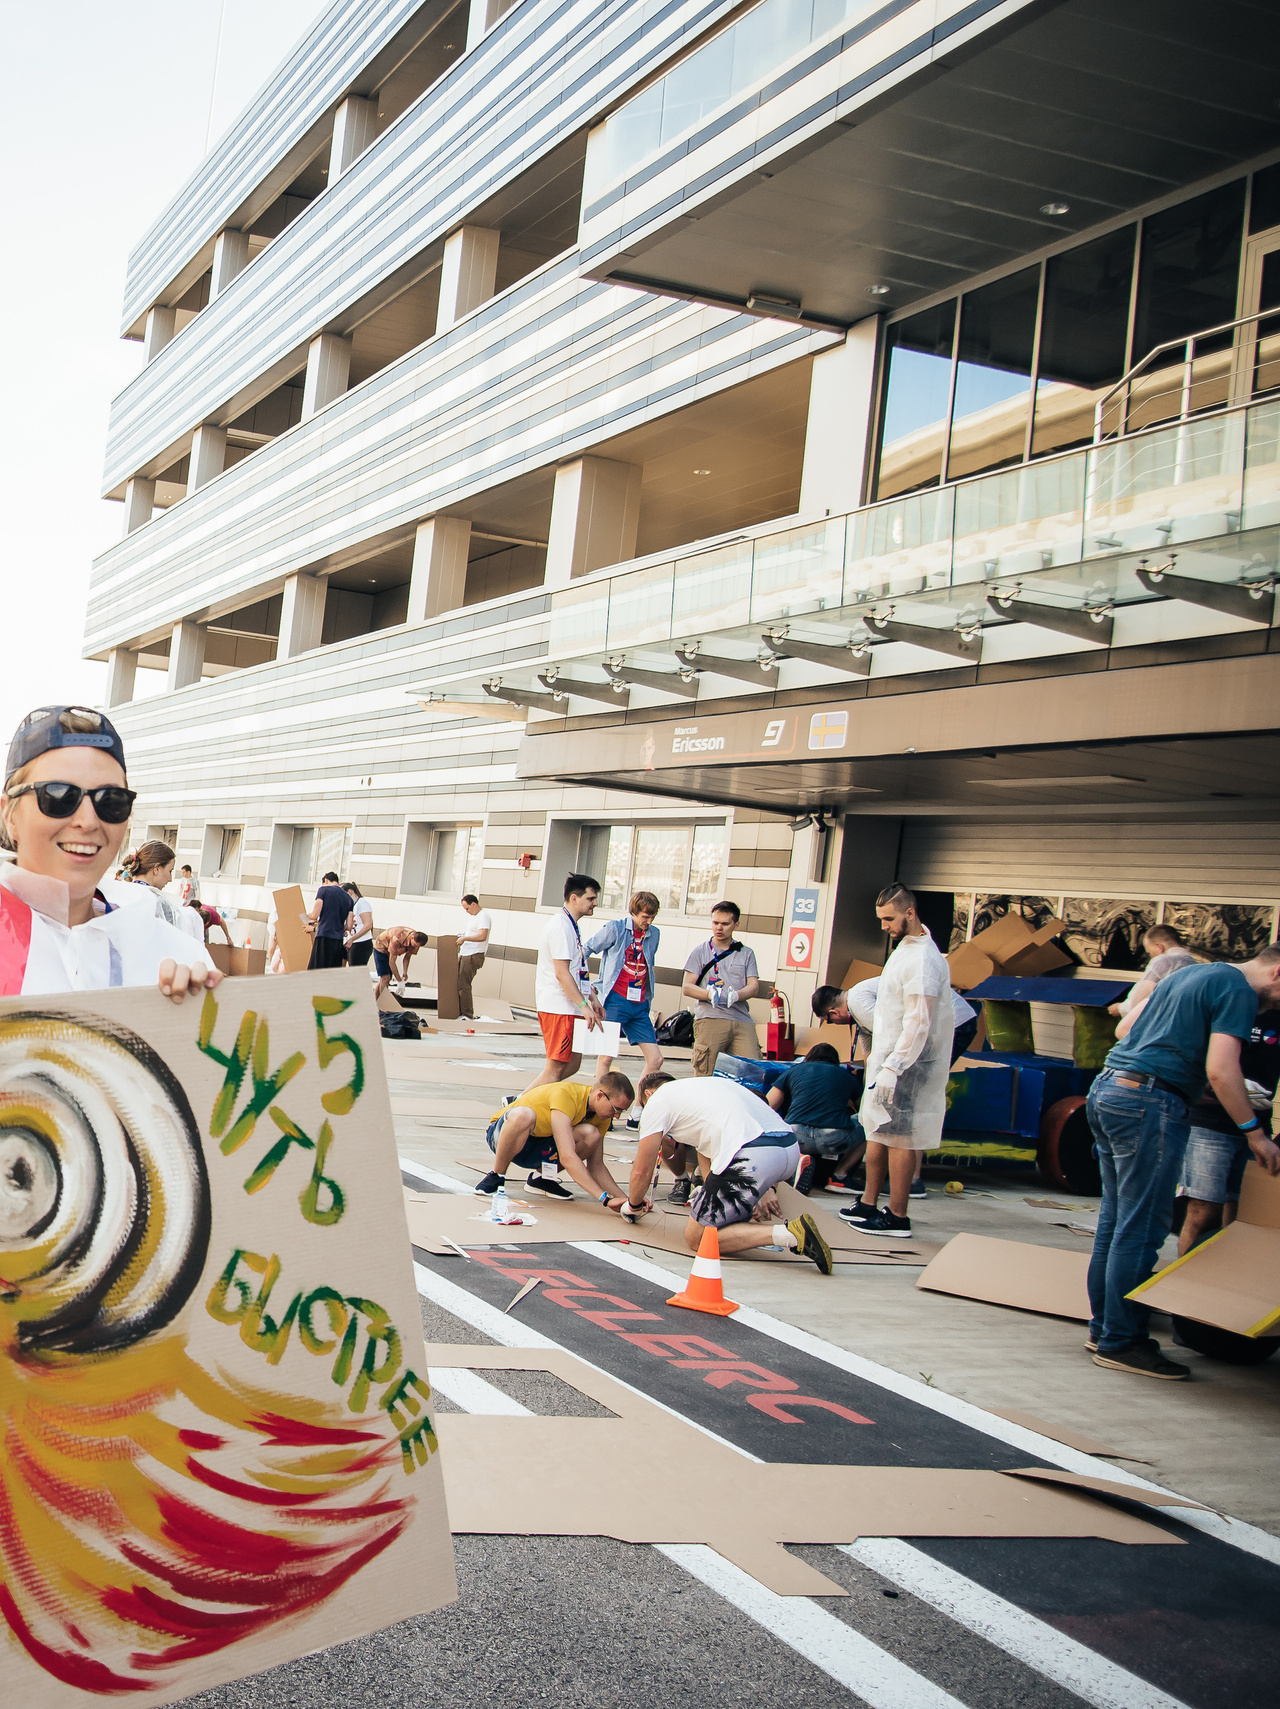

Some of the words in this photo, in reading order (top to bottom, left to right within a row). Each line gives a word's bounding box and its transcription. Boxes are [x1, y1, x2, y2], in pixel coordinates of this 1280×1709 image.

[674, 726, 698, 736] Marcus
[672, 736, 725, 753] Ericsson
[795, 898, 816, 914] 33
[466, 1250, 878, 1425] LECLERC
